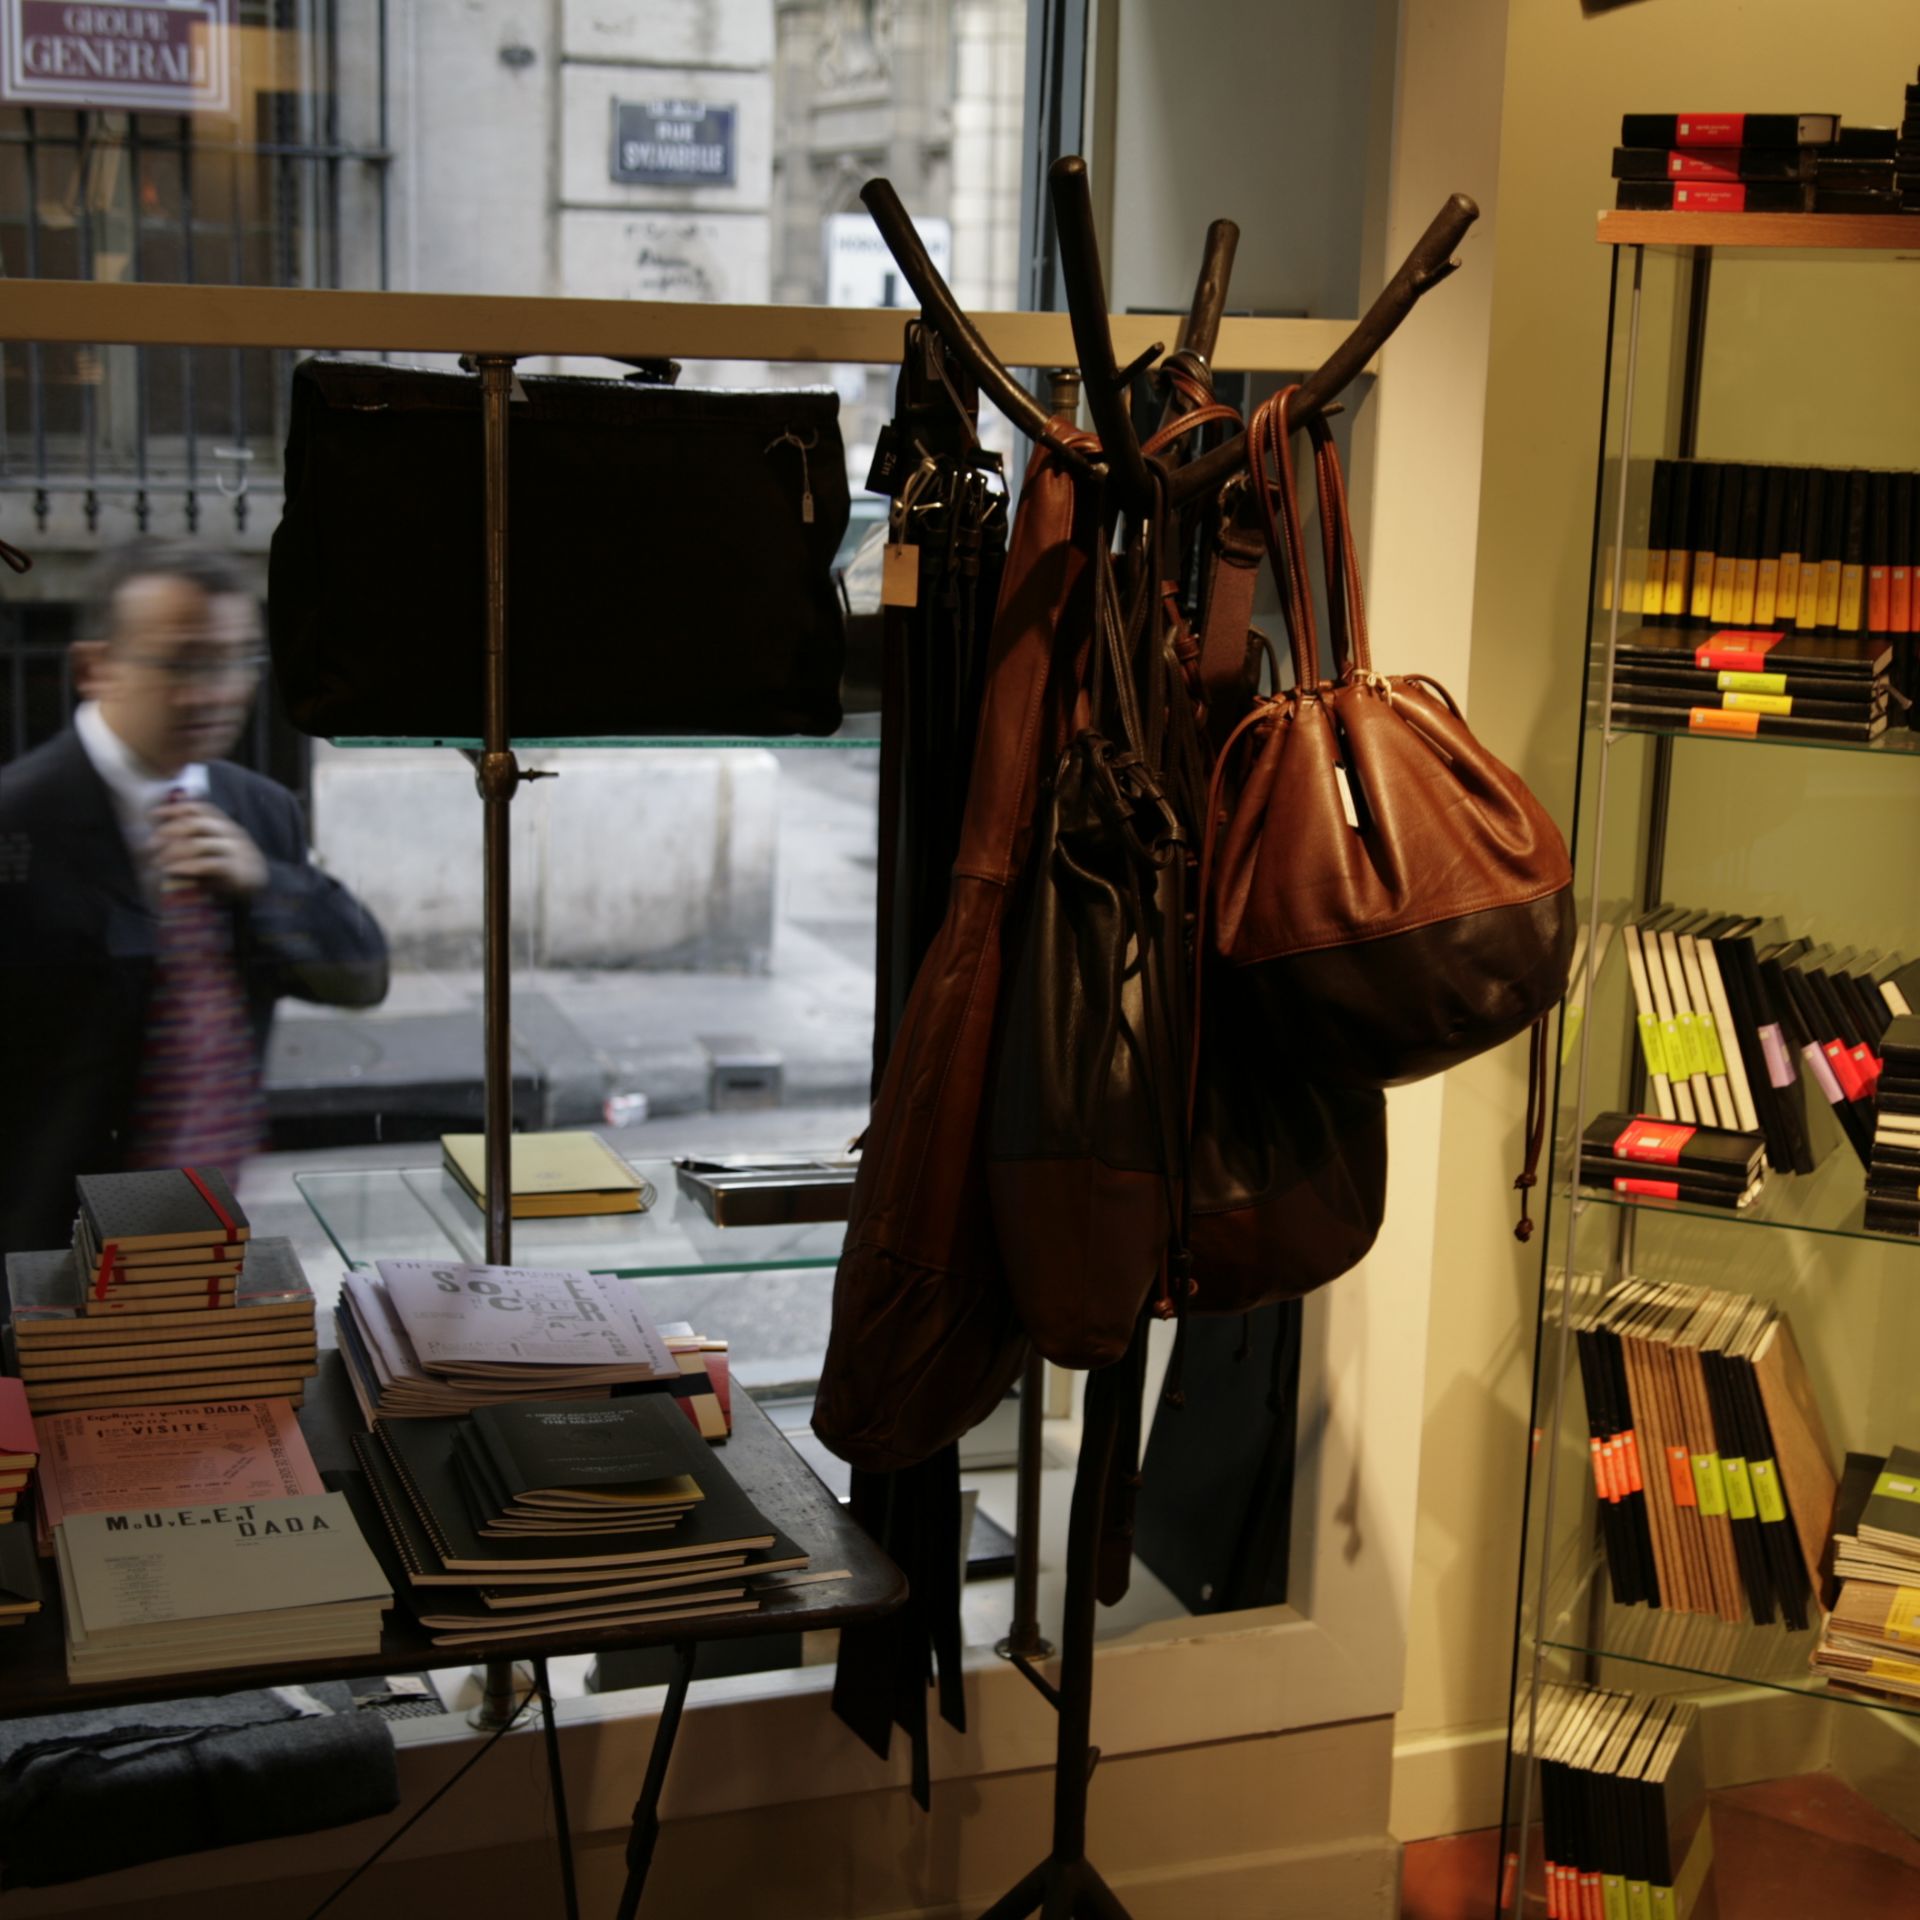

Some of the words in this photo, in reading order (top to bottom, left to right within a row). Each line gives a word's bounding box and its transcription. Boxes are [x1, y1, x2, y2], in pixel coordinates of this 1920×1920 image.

[64, 7, 168, 40] GROUPE
[203, 1404, 251, 1415] DADA
[238, 1514, 330, 1537] DADA
